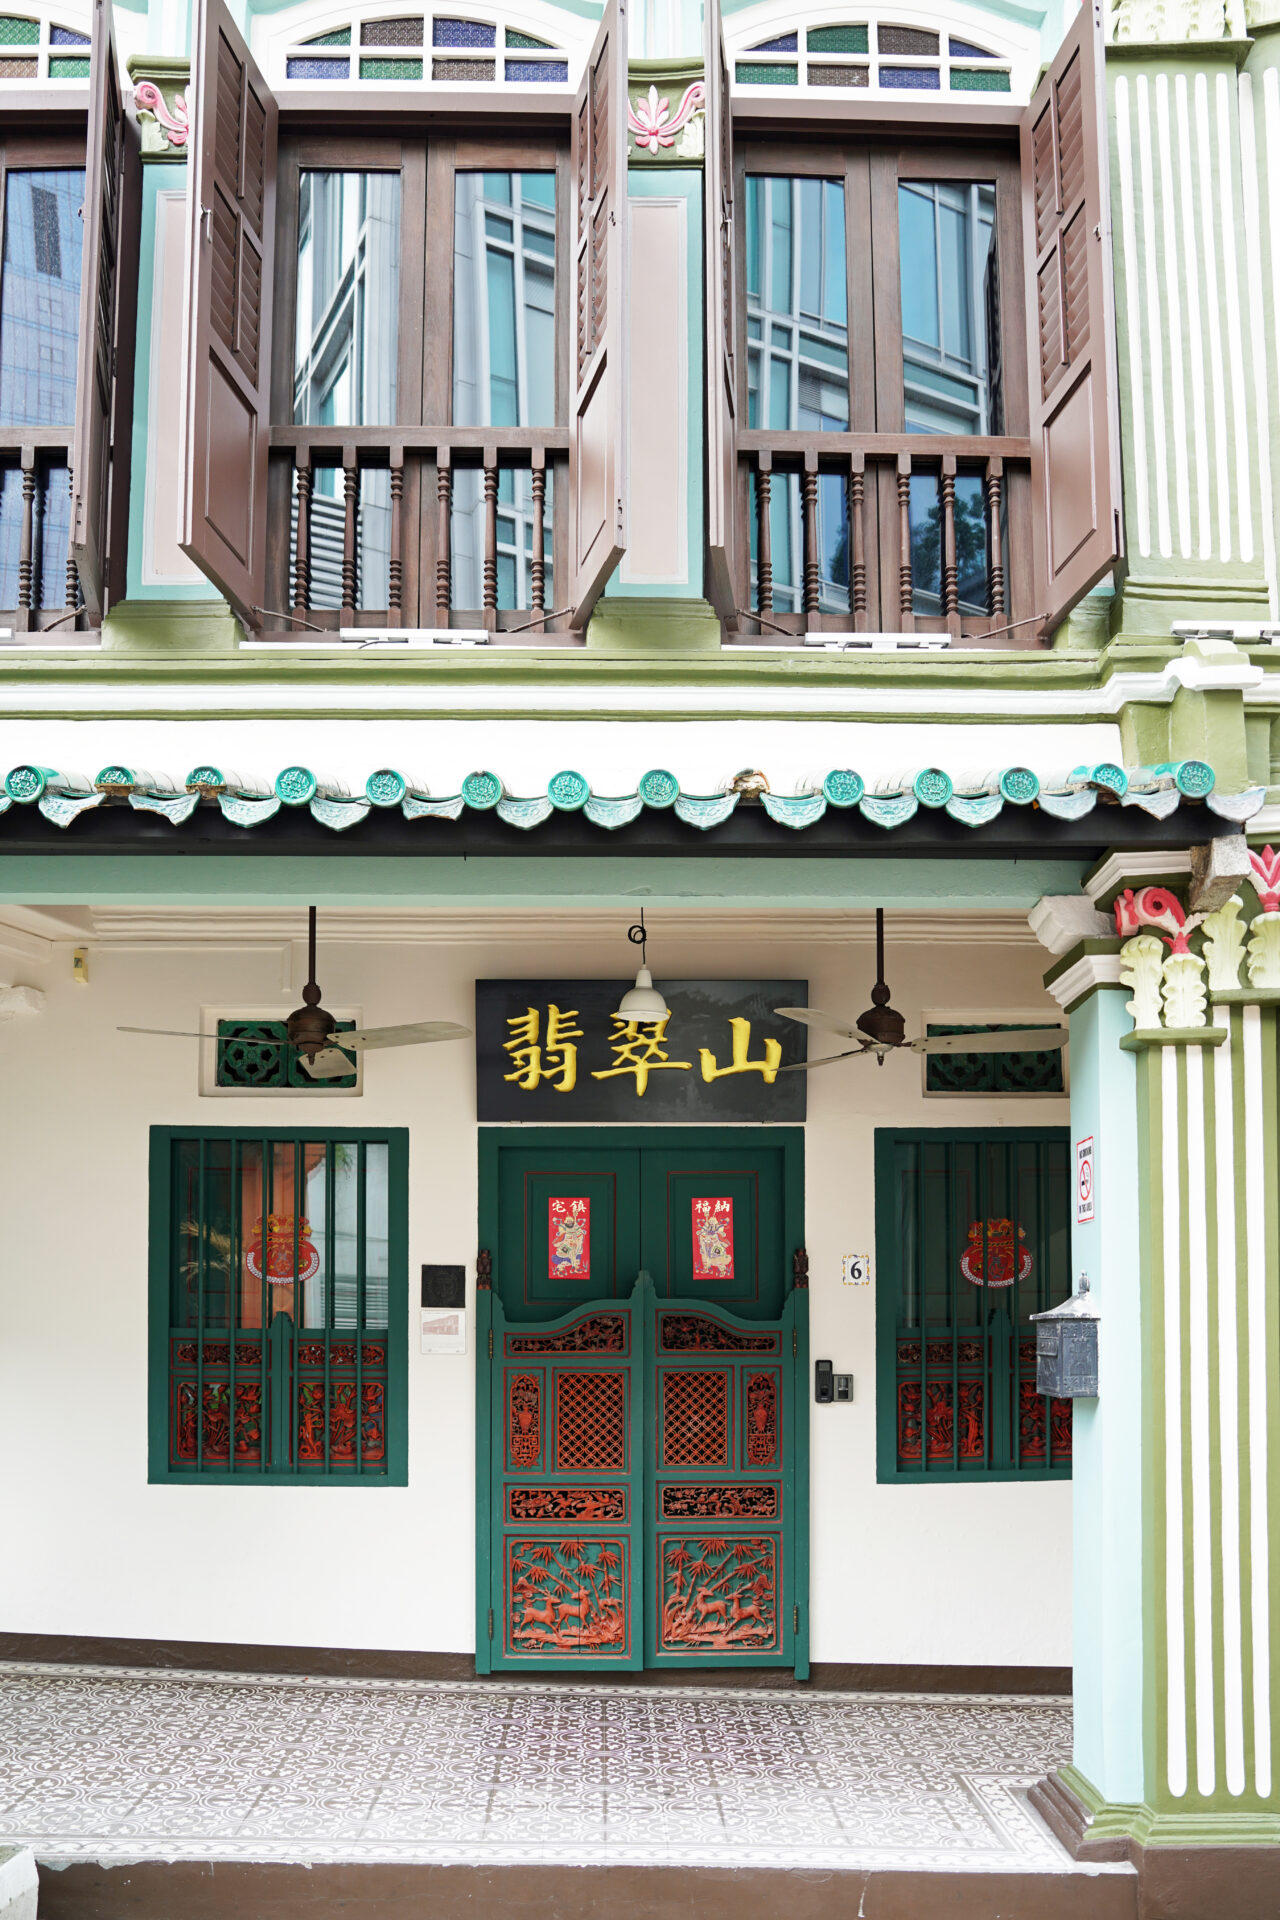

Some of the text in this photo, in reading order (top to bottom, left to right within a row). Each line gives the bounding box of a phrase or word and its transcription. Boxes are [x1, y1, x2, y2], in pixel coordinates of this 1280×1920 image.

[502, 1003, 782, 1097] 翡翠山
[850, 1260, 863, 1280] 6
